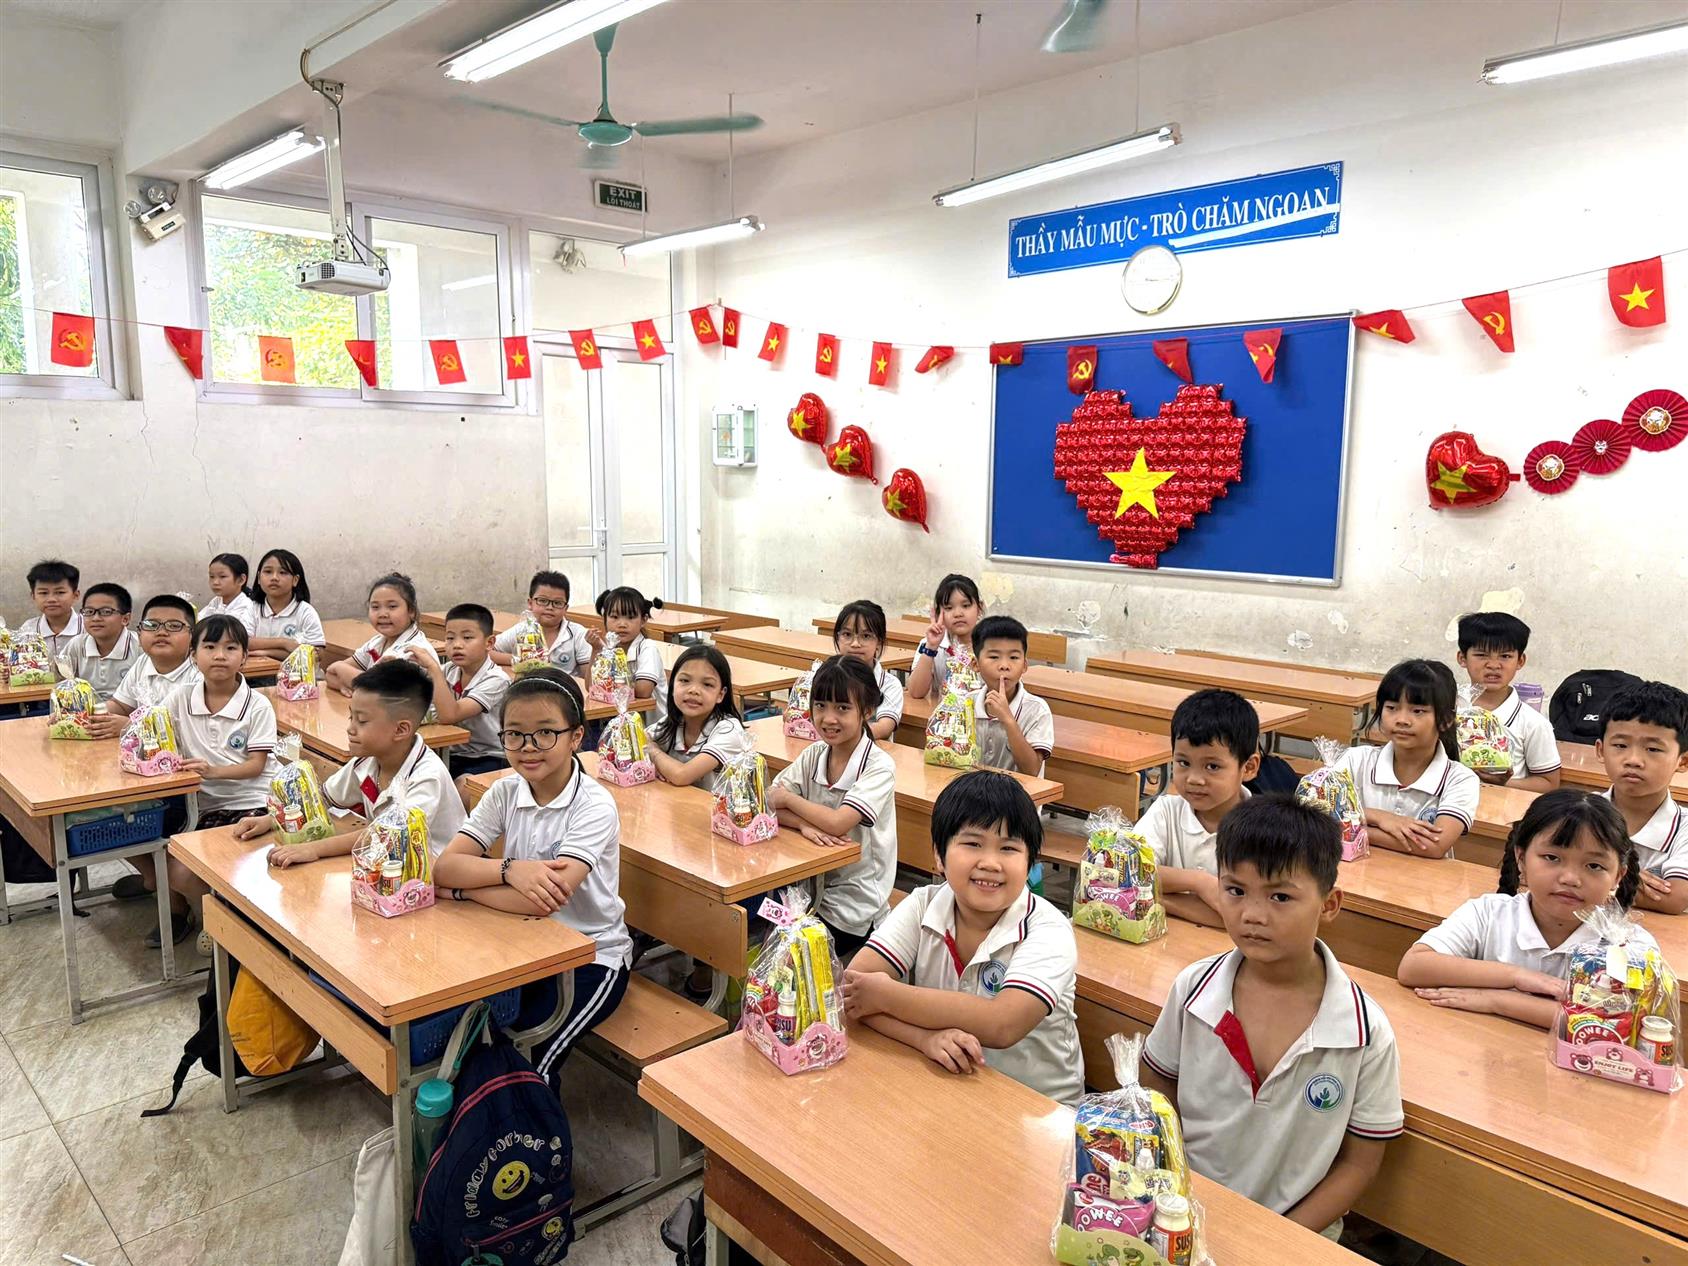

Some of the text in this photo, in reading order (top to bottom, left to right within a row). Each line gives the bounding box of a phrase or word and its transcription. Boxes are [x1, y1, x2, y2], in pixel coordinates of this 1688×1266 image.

[610, 186, 637, 200] EXIT
[1015, 222, 1058, 258] THẦY
[1060, 215, 1097, 252] MẪU
[1100, 215, 1139, 248] MỰC
[1150, 203, 1188, 237] TRÒ
[1191, 195, 1250, 231] CHĂM
[1254, 187, 1330, 223] NGOAN
[1594, 1060, 1634, 1073] ENJOY LIFE
